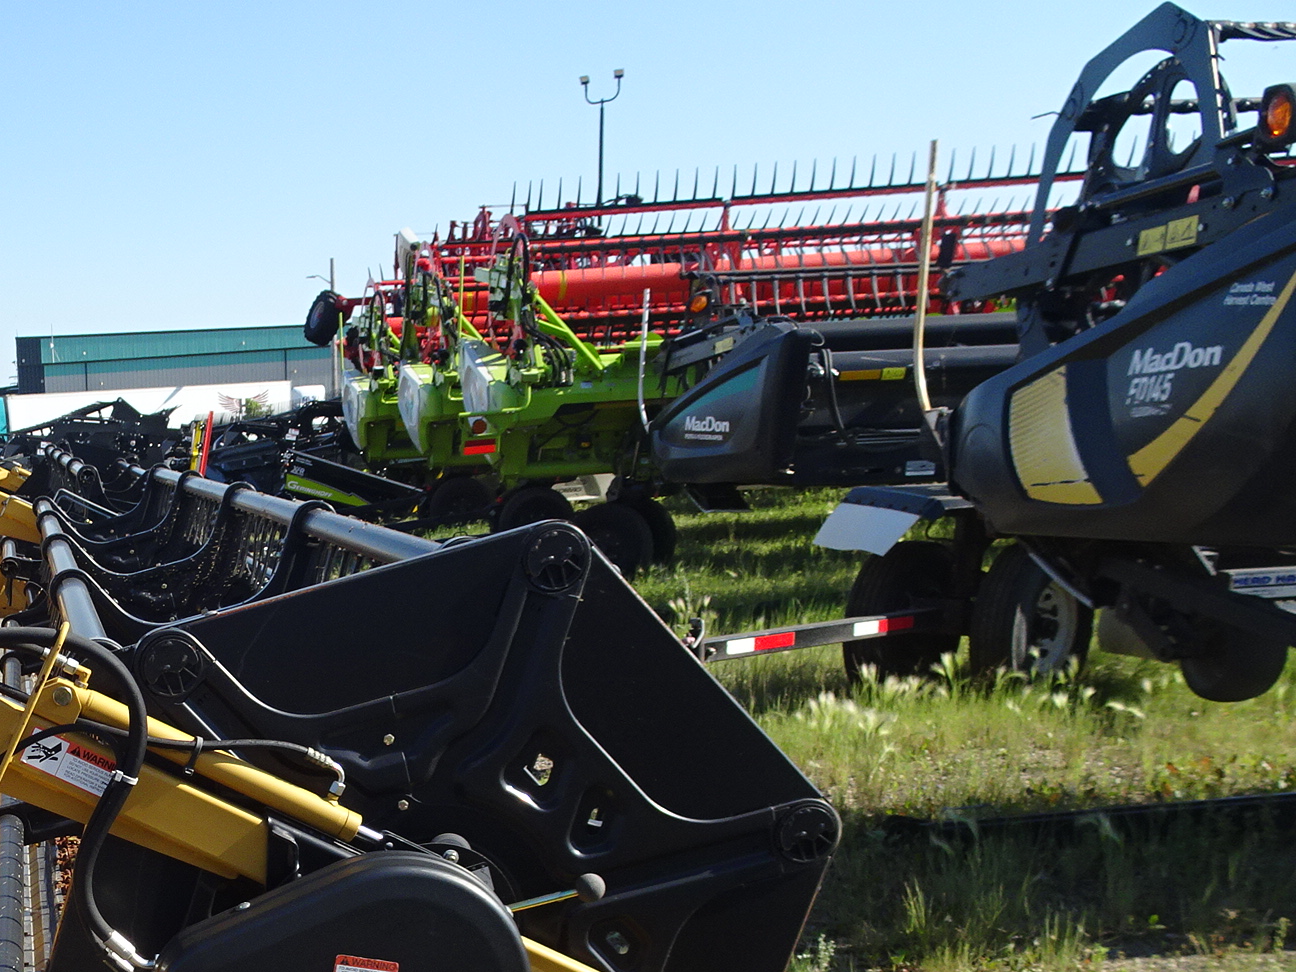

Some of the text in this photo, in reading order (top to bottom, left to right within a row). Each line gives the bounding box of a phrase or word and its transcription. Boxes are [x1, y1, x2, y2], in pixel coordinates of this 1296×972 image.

[1127, 341, 1222, 376] MacDon
[685, 416, 730, 432] MacDon
[83, 750, 115, 771] WARNI
[352, 958, 395, 970] WARNING
